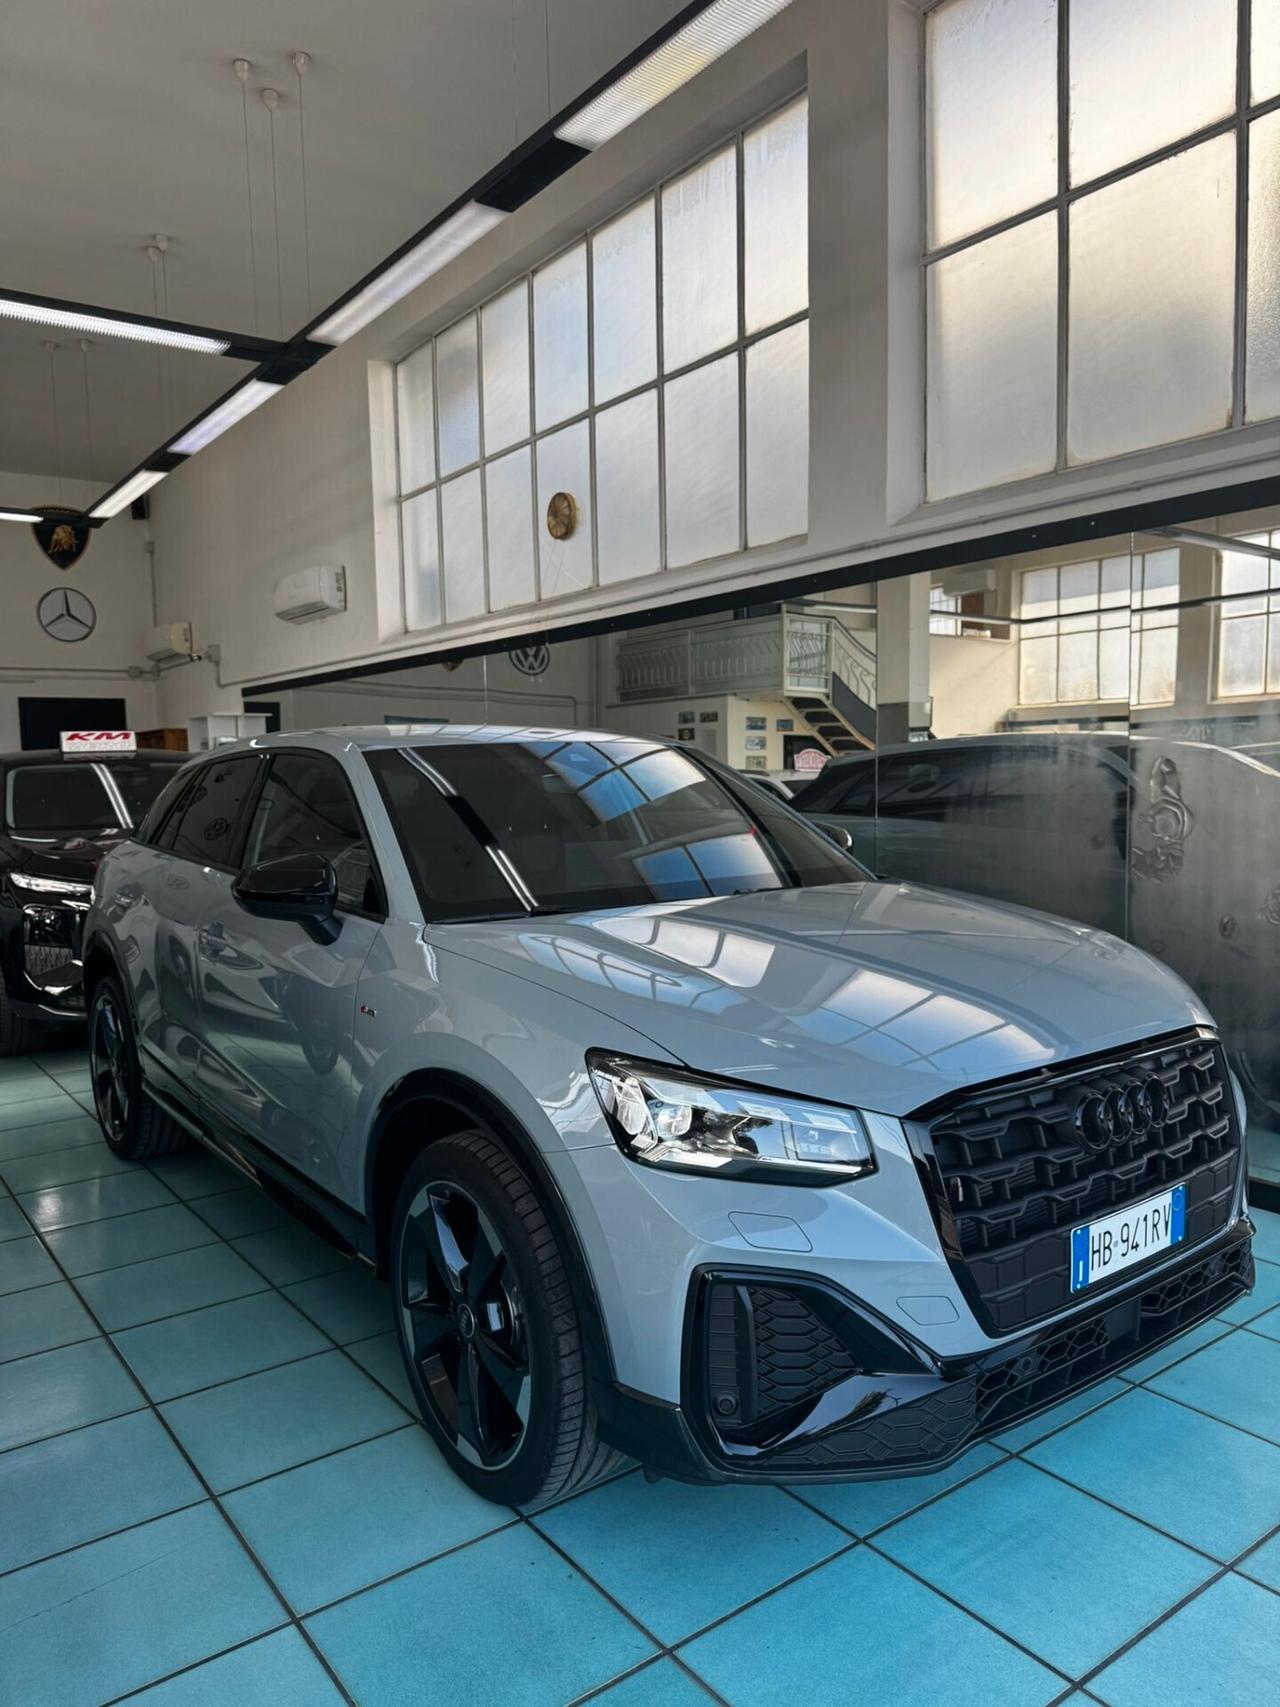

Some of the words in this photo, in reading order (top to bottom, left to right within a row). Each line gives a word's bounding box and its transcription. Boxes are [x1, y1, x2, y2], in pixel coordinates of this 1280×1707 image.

[66, 732, 131, 741] KM
[1091, 1230, 1113, 1271] HB
[1120, 1202, 1172, 1258] 941RV
